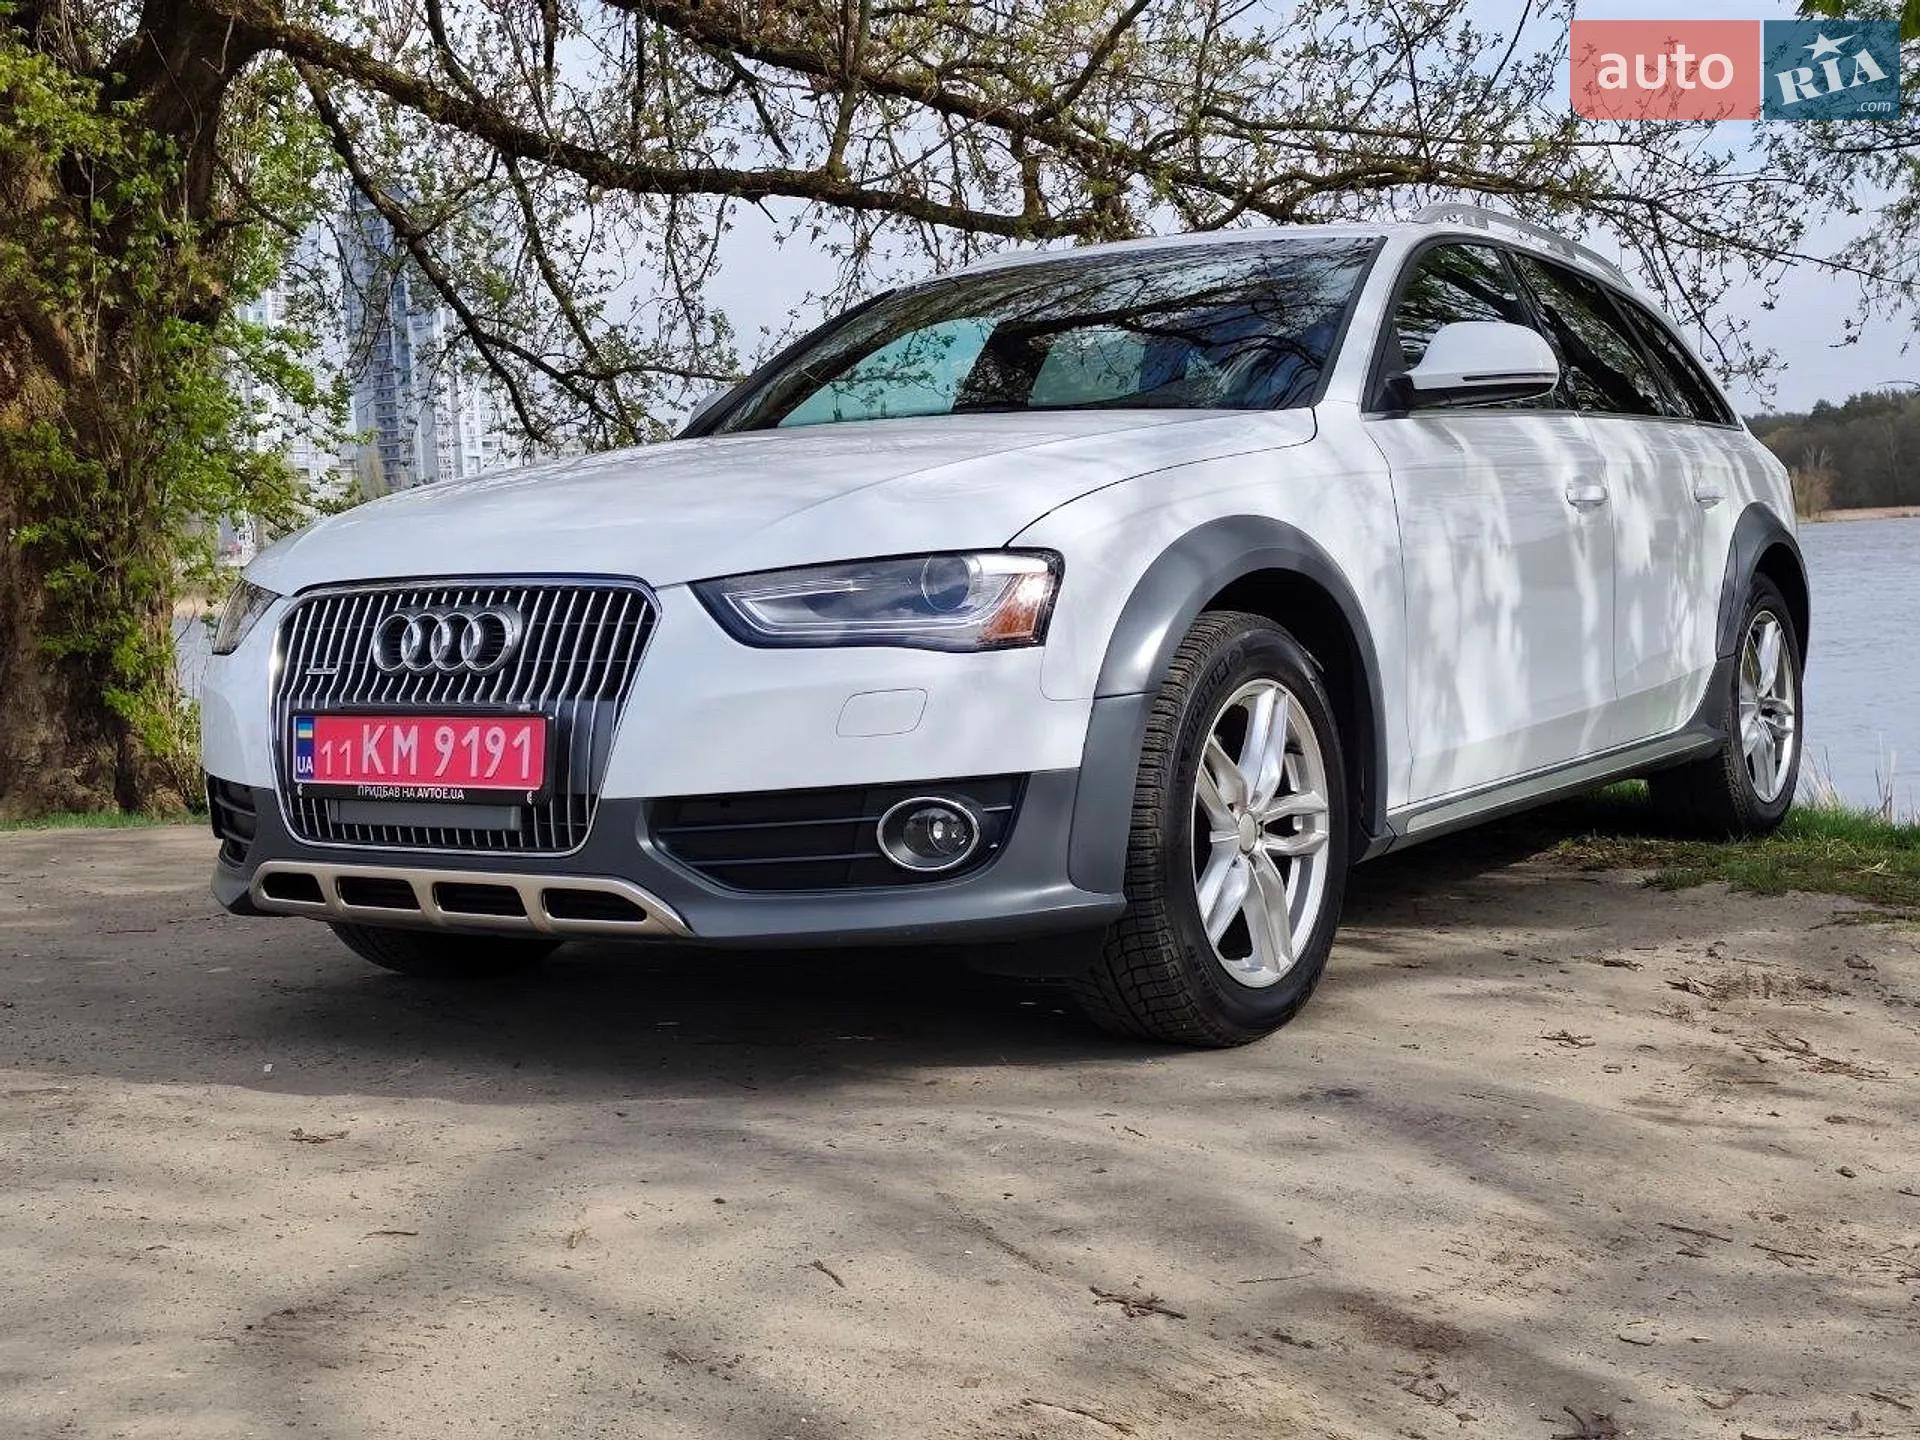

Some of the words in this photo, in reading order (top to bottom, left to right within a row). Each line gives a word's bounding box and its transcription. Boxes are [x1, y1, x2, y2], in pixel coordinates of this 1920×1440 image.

[320, 739, 351, 776] 11
[361, 723, 419, 776] KM
[434, 726, 531, 780] 9191
[297, 755, 313, 774] UA
[357, 785, 400, 798] ПРИДБАВ
[402, 787, 415, 798] НА
